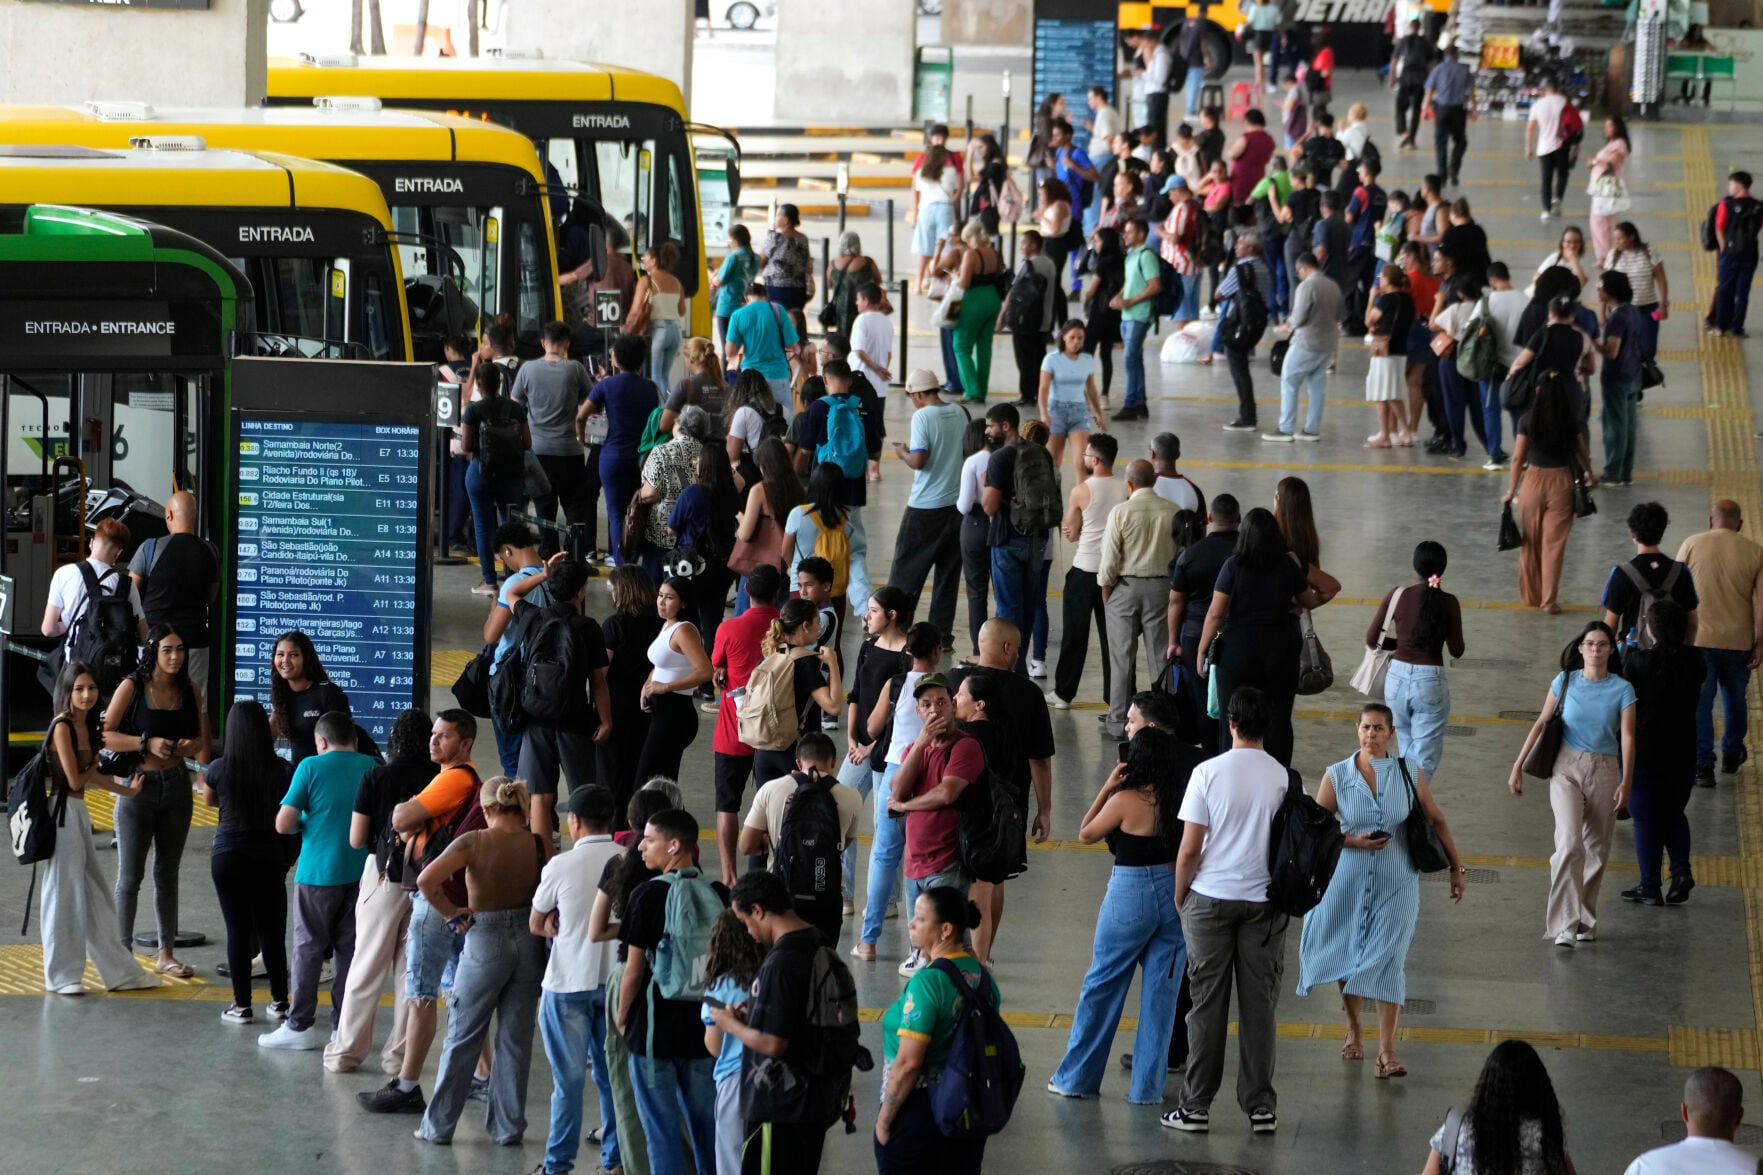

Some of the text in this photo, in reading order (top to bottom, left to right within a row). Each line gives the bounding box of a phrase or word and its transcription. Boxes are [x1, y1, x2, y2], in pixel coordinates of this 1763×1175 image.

[572, 115, 630, 128] ENTRADA
[395, 178, 464, 193] ENTRADA
[239, 226, 314, 242] ENTRADA
[598, 302, 620, 322] 10
[25, 322, 175, 334] ENTRADA ENTRANCE
[438, 396, 452, 420] 9
[263, 440, 310, 449] Samambaia
[380, 448, 418, 458] E7 13:30
[262, 466, 290, 474] Riacho
[292, 466, 318, 476] Fundo
[306, 476, 318, 484] Do
[320, 477, 344, 486] Plano
[378, 474, 418, 484] E5 13:30
[262, 490, 290, 500] Cidade
[376, 500, 417, 508] E11 13:30
[262, 516, 309, 524] Samambaia
[378, 524, 416, 534] E8 13:30
[262, 541, 277, 550] São
[374, 550, 416, 559] A14 13:30
[337, 568, 348, 577] Do
[260, 576, 284, 584] Plano
[374, 575, 416, 584] A11 13:30
[260, 590, 276, 600] São
[372, 600, 415, 609] A11 13:30
[260, 616, 278, 626] Park
[372, 626, 414, 635] A12 13:30
[333, 644, 356, 653] Plano
[374, 650, 414, 660] A7 13:30
[374, 676, 386, 684] A8
[372, 700, 384, 709] A8
[372, 726, 384, 734] A8
